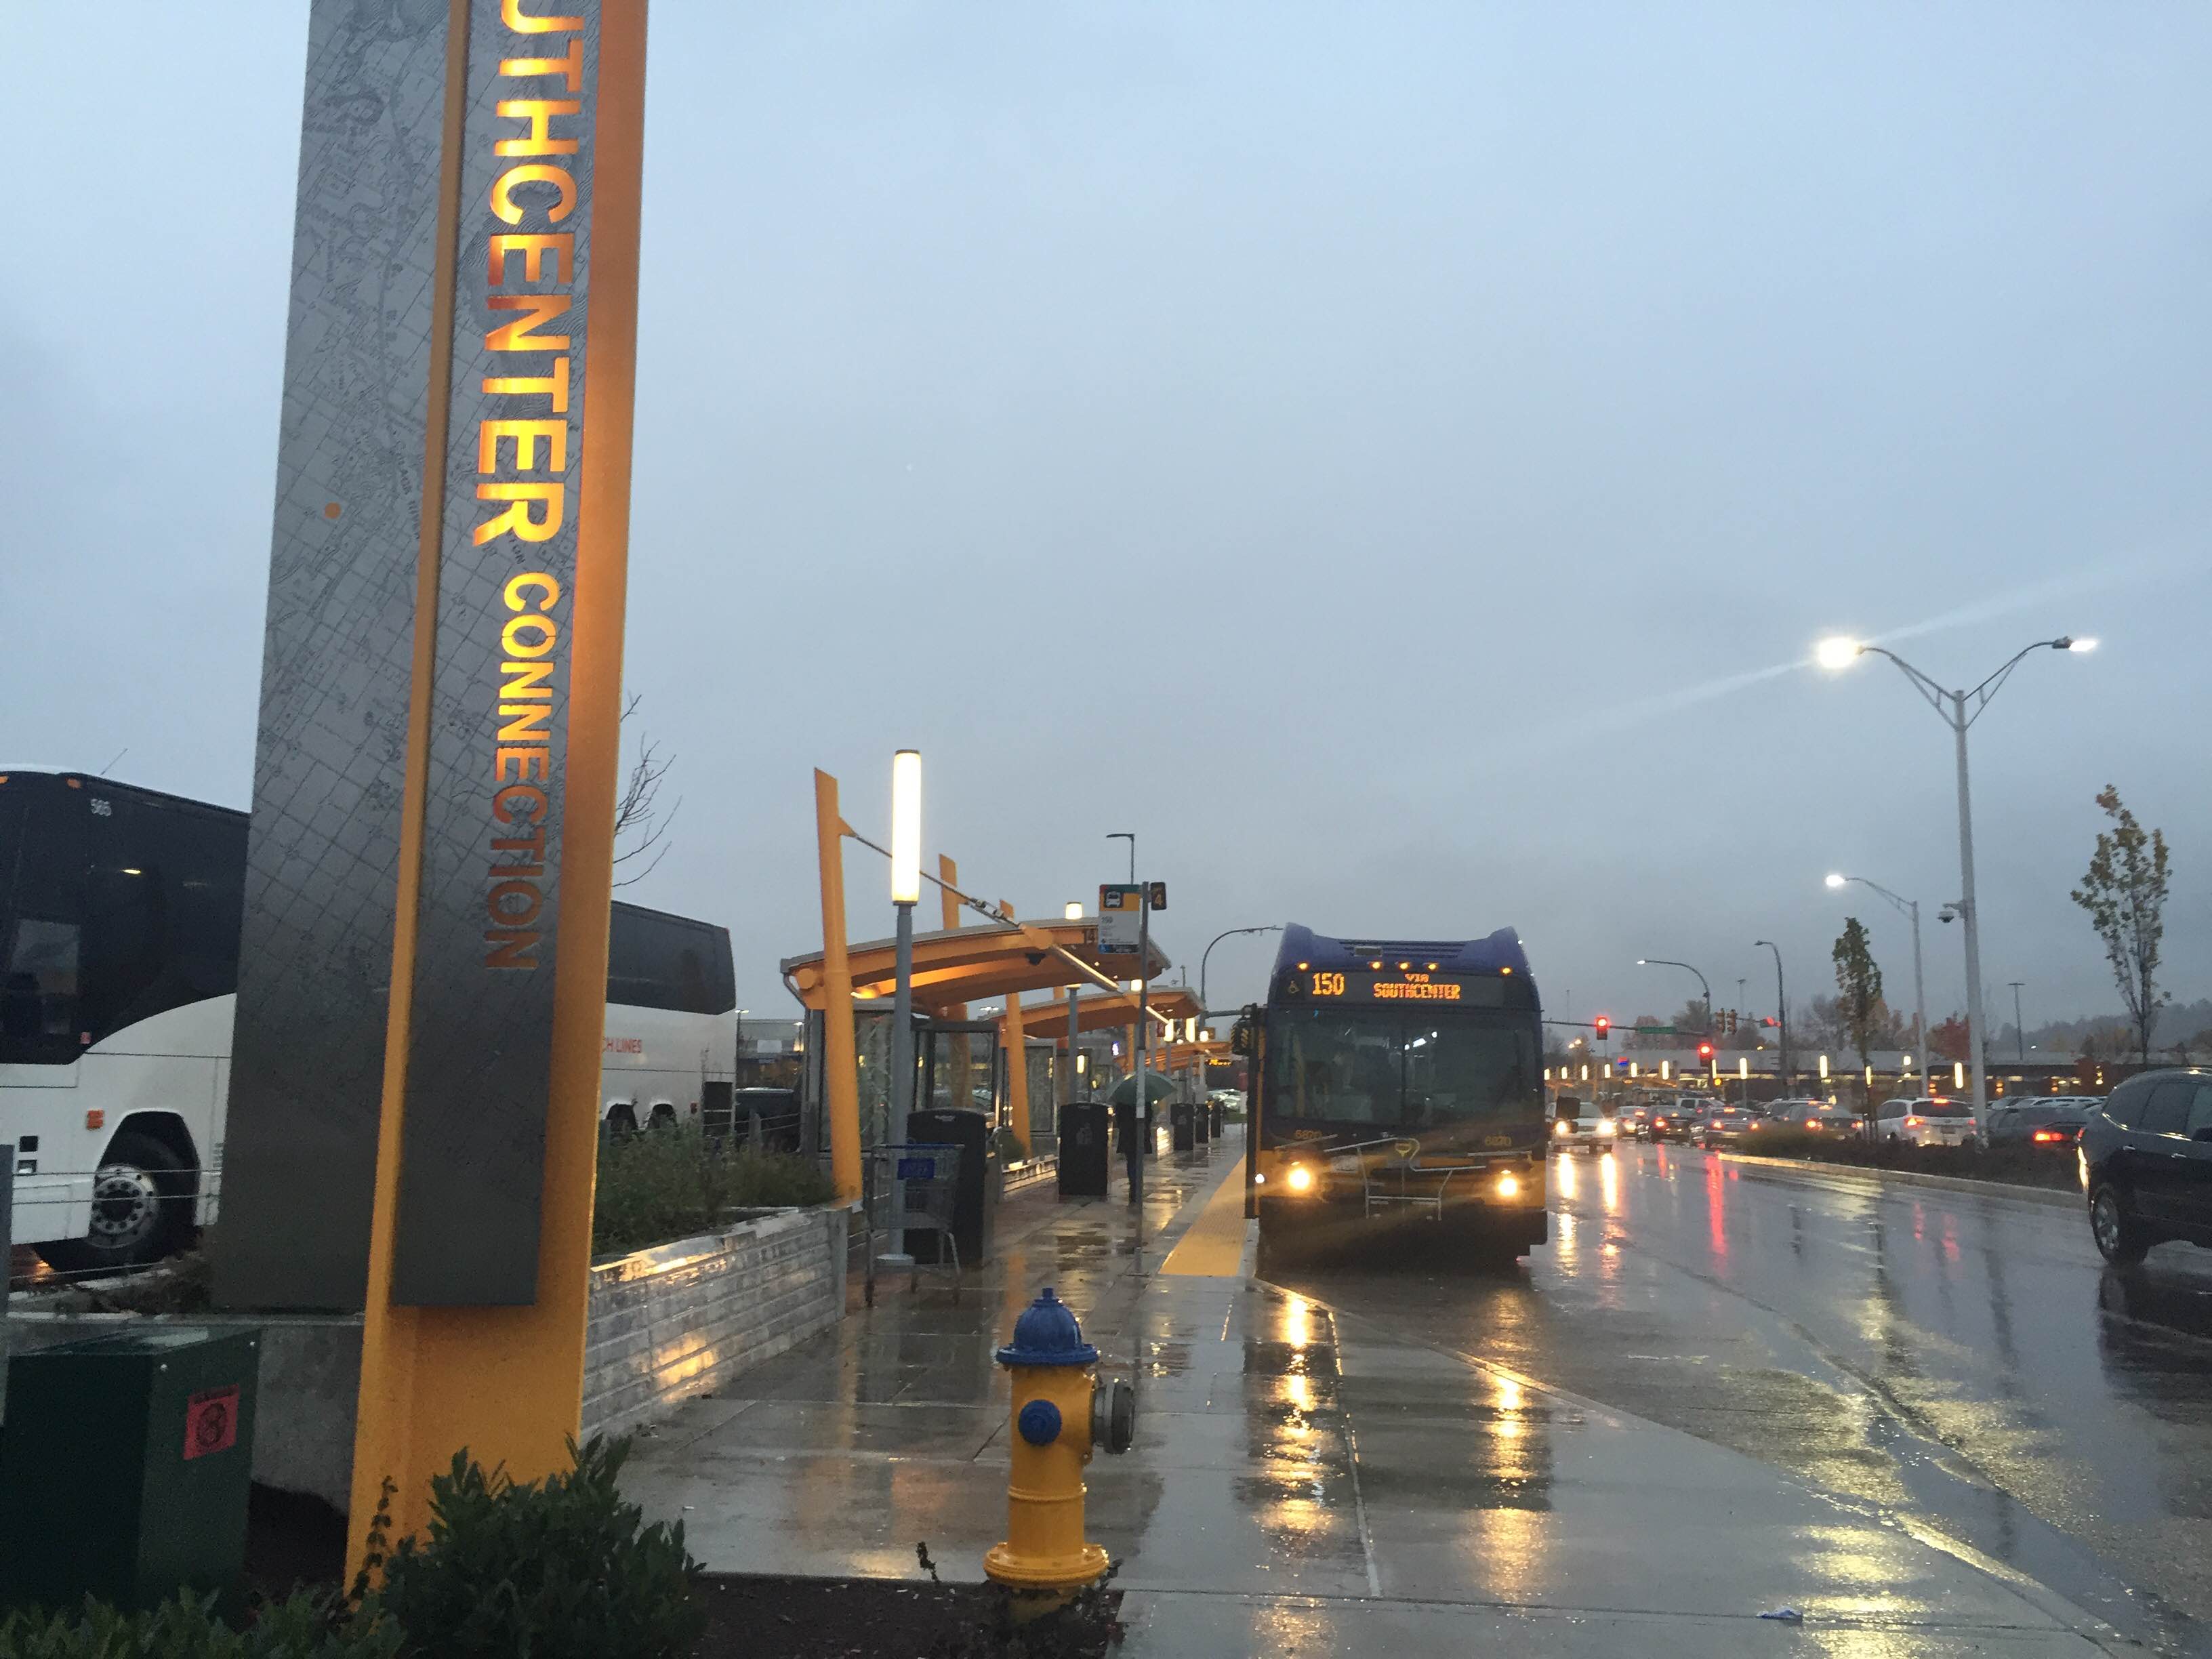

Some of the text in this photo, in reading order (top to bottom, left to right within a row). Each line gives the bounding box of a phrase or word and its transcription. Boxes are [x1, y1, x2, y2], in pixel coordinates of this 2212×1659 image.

[485, 571, 561, 970] CONNECTION
[1312, 972, 1345, 996] 150
[1404, 974, 1429, 983] VIA
[1373, 983, 1460, 1000] SOUTHCENTER
